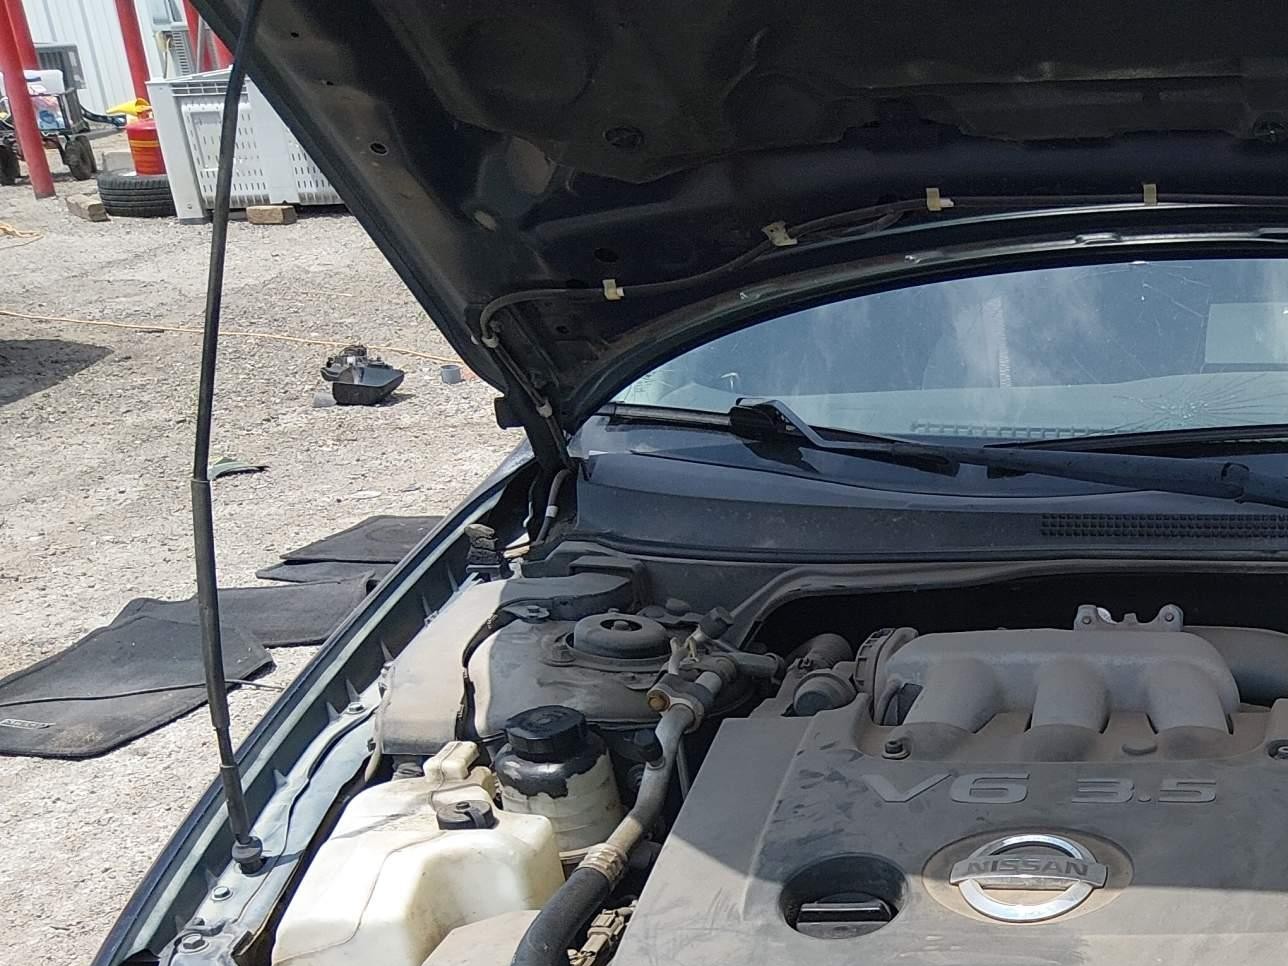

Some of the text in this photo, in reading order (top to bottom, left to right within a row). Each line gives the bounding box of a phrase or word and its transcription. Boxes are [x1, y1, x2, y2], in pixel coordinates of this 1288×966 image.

[862, 772, 1217, 804] V6 3.5
[966, 856, 1089, 877] NISSAN
